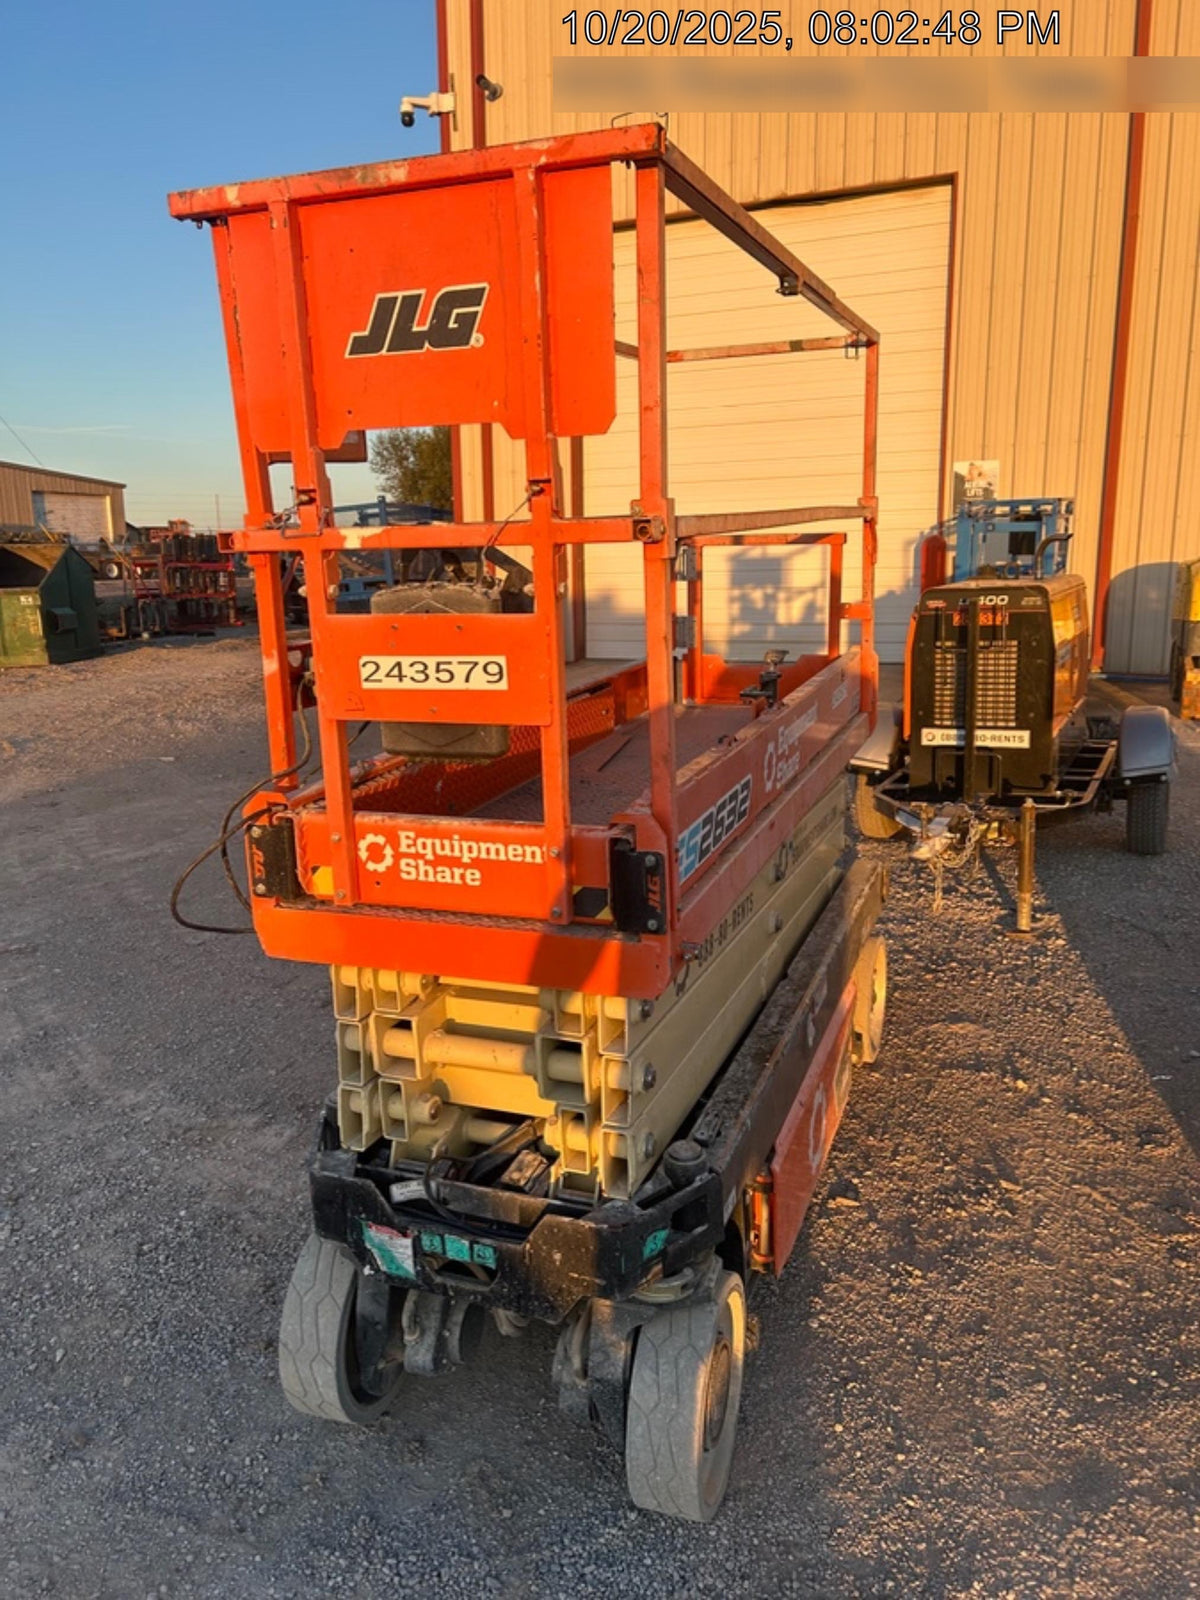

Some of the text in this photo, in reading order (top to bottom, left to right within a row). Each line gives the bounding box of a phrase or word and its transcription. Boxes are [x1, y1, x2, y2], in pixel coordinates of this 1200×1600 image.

[344, 282, 490, 359] JLG
[361, 660, 504, 684] 243579
[398, 830, 547, 864] Equipmen
[399, 858, 482, 886] Share
